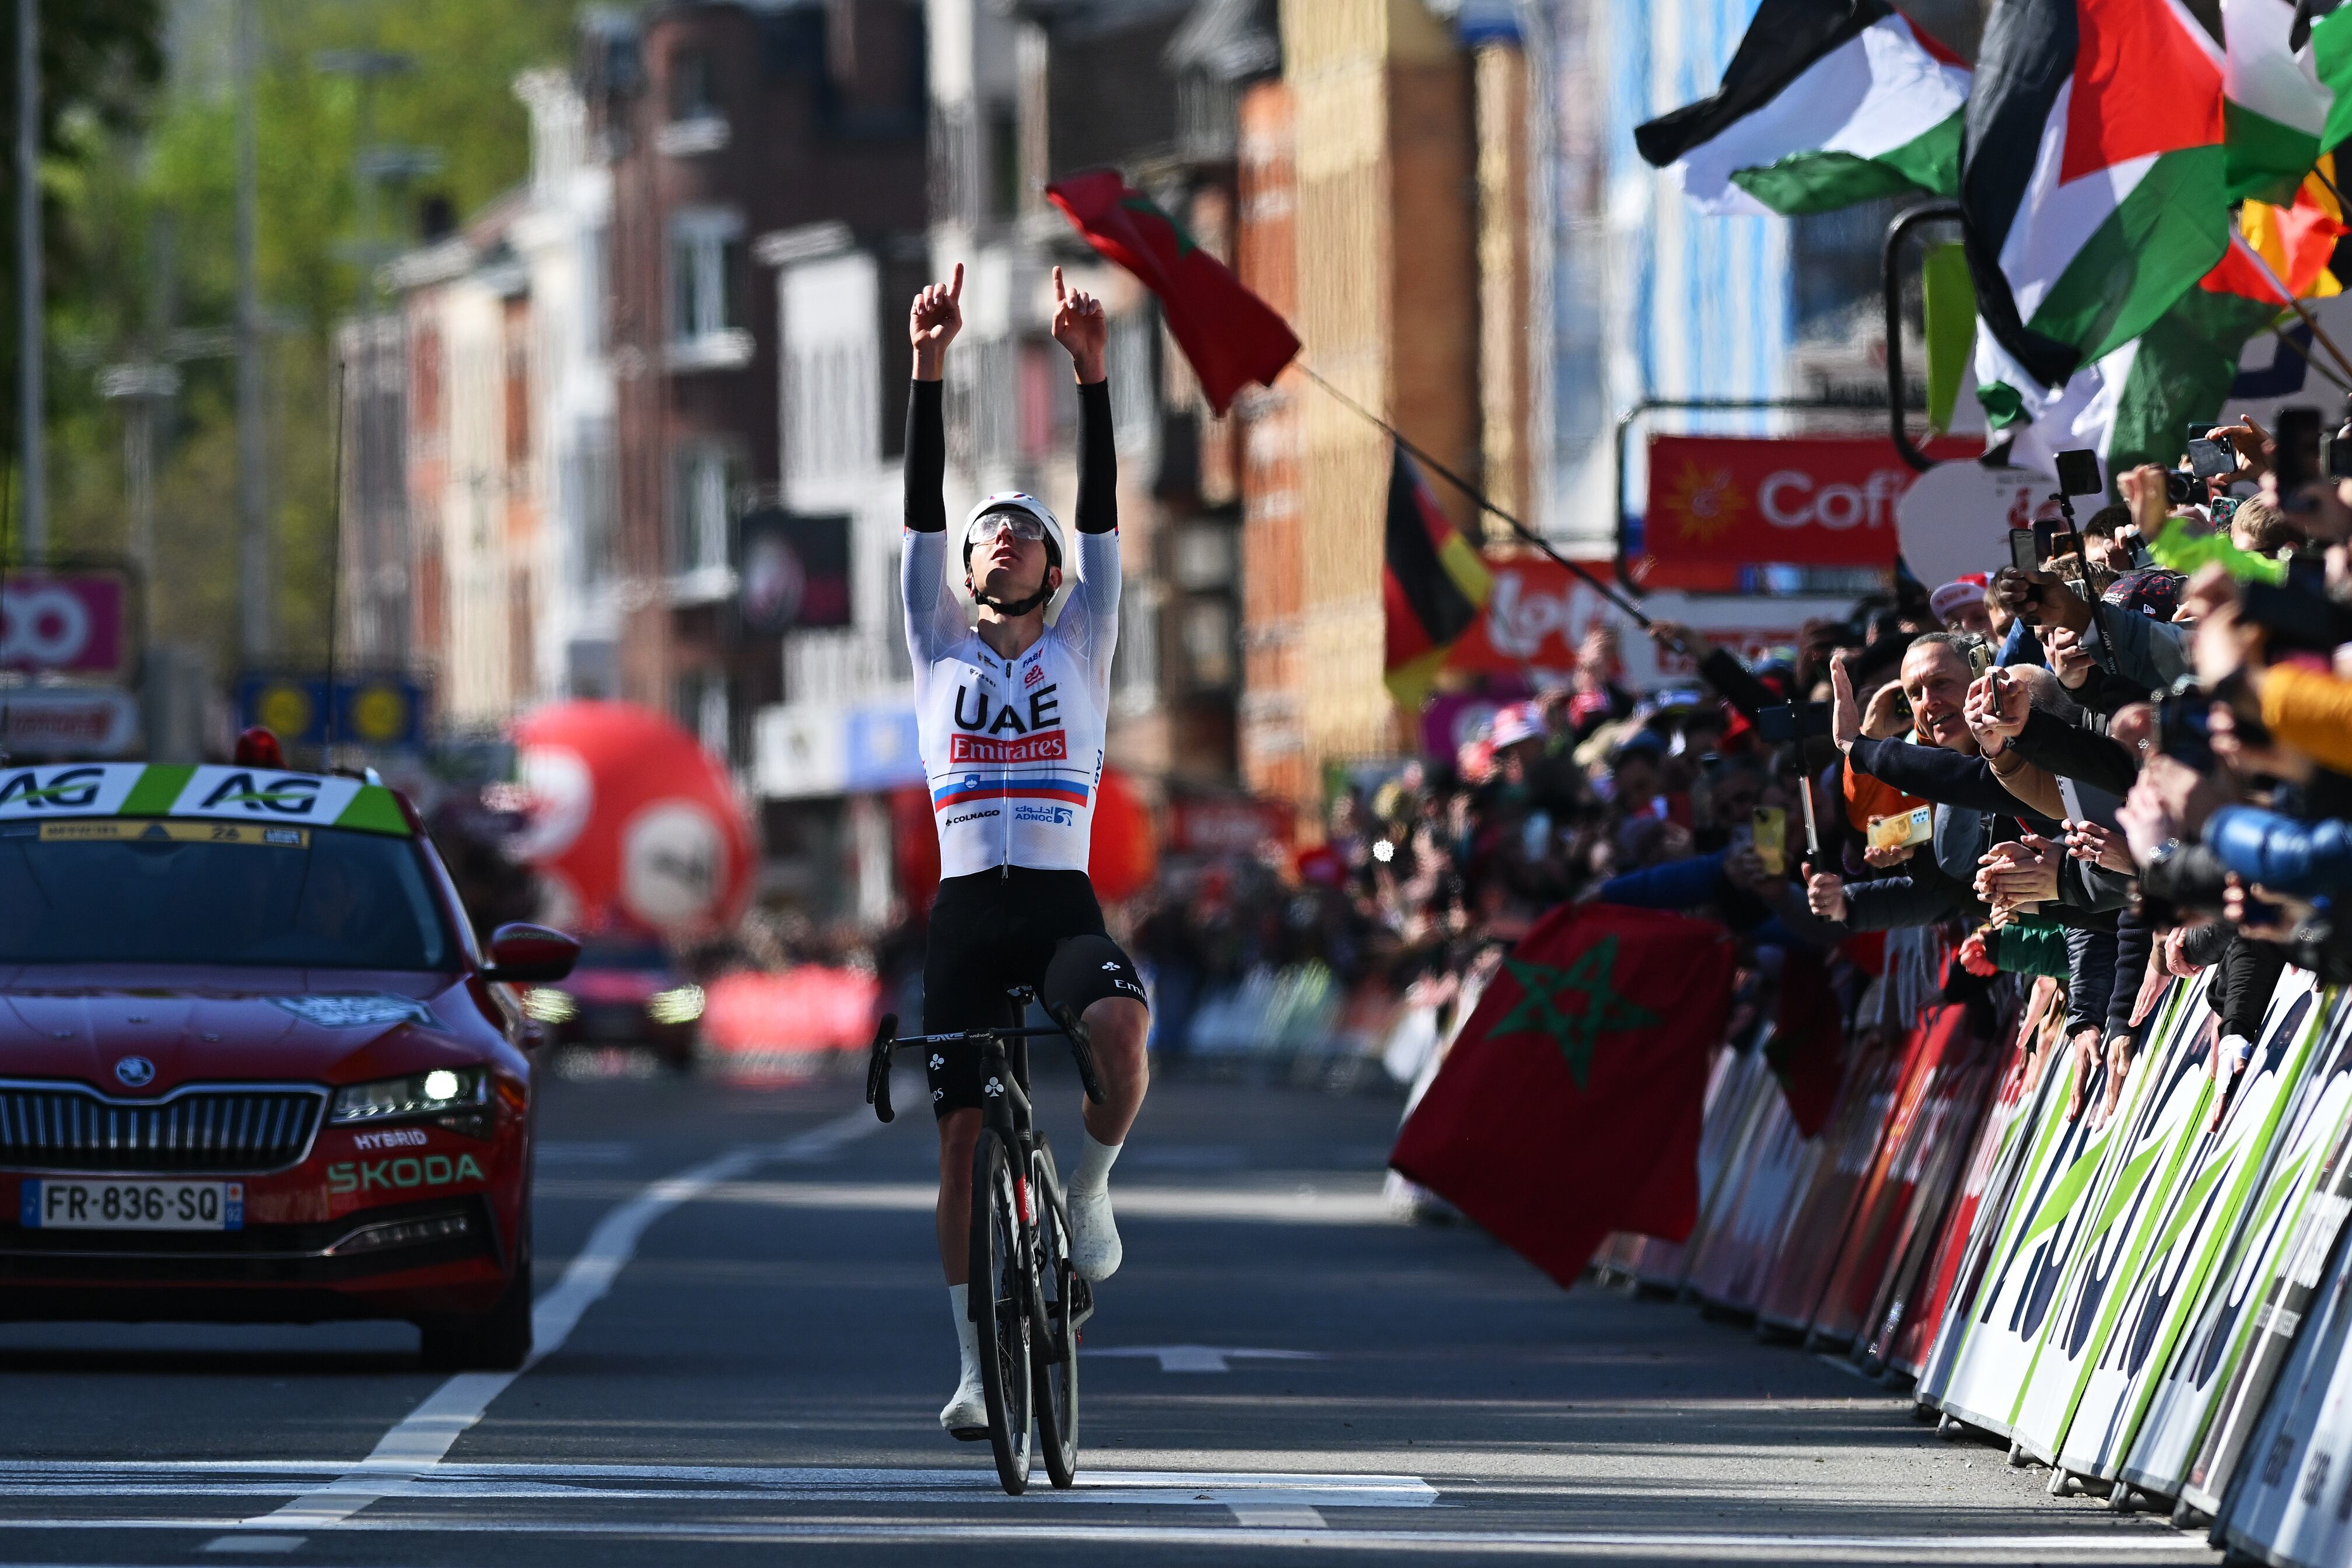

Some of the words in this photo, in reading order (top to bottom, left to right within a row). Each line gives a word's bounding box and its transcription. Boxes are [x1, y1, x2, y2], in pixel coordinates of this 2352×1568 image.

[1756, 470, 1905, 528] Cofi
[954, 684, 1061, 735] UAE
[953, 737, 1063, 761] Emirates
[200, 773, 321, 815] AG
[953, 810, 1000, 824] COLNAGO
[1015, 813, 1052, 822] ADNOC
[354, 1128, 429, 1150] HYBRID
[47, 1185, 218, 1221] FR-836-SQ
